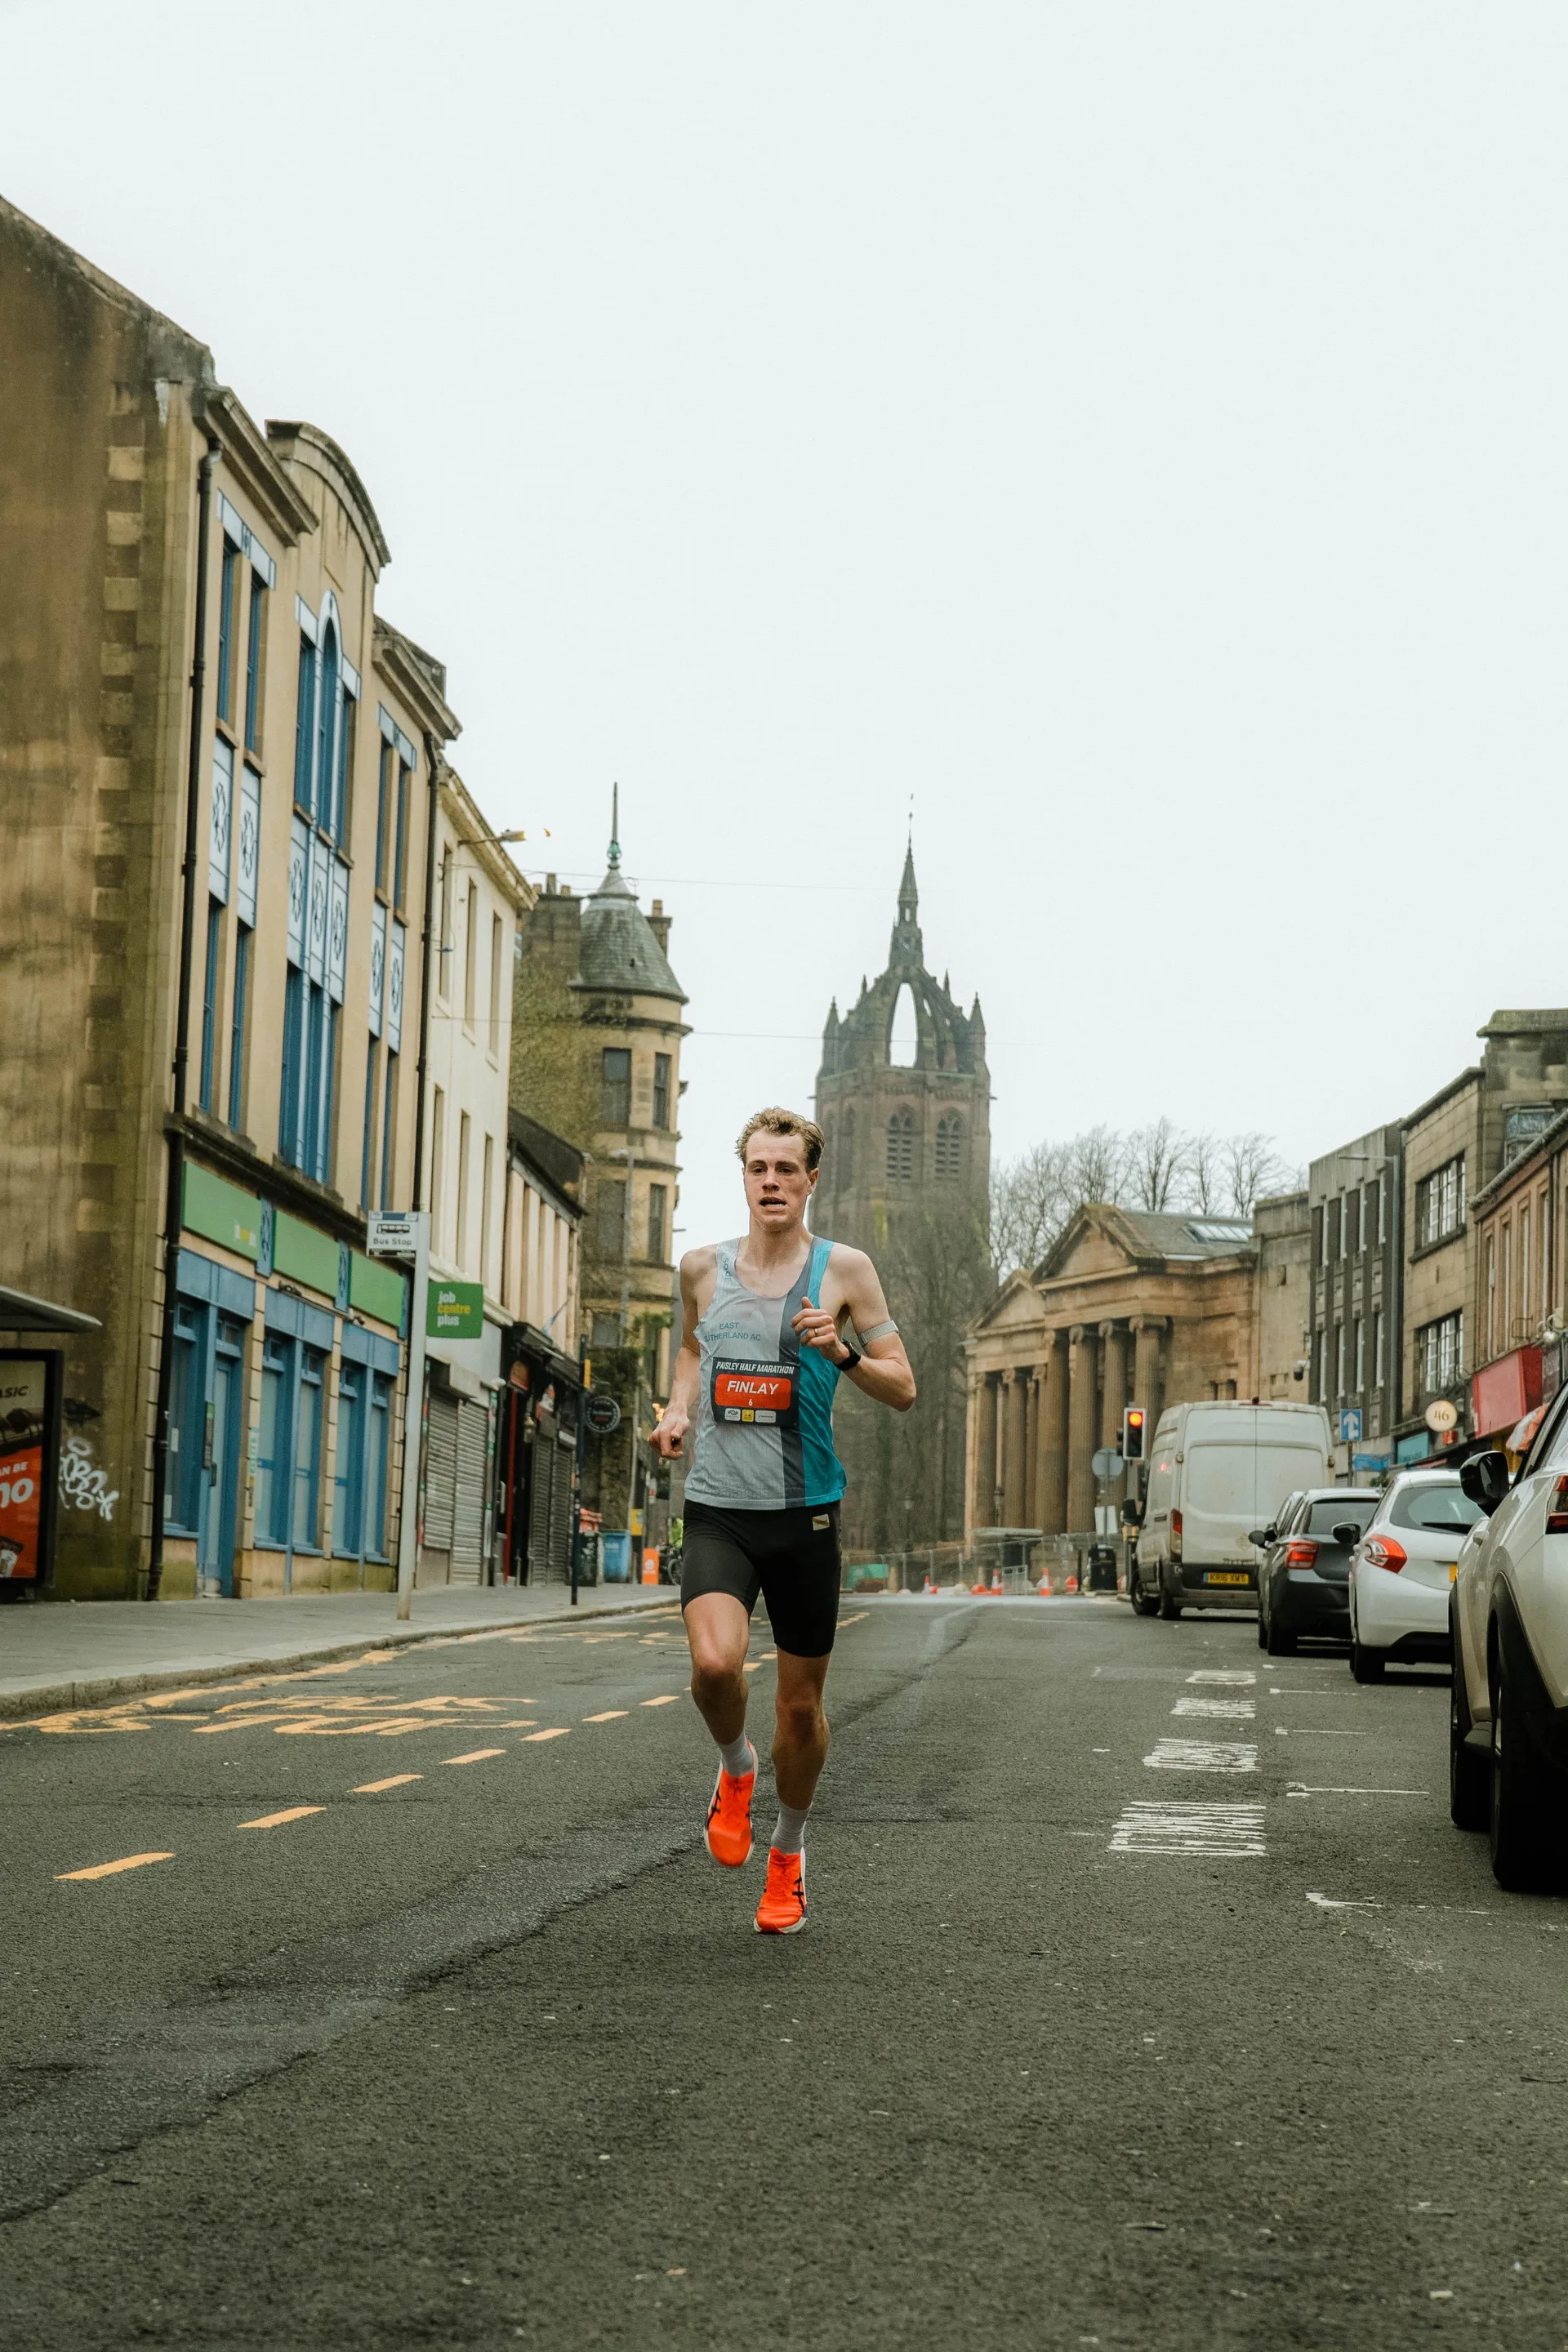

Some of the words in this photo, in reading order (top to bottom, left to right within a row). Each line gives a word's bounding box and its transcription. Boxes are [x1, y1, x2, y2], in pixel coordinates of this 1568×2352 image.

[372, 1237, 390, 1245] Bus
[392, 1238, 412, 1247] Stop
[438, 1290, 456, 1304] job
[437, 1304, 471, 1314] centre
[437, 1314, 460, 1328] plus
[704, 1332, 749, 1342] SUTHERLAND
[715, 1361, 740, 1370] PAISLEY
[739, 1362, 757, 1372] HALF
[756, 1364, 795, 1374] MARATHON
[727, 1380, 778, 1395] FINLAY
[1434, 1409, 1450, 1421] 46
[12, 1461, 28, 1473] BE
[39, 1714, 539, 1735] STOP
